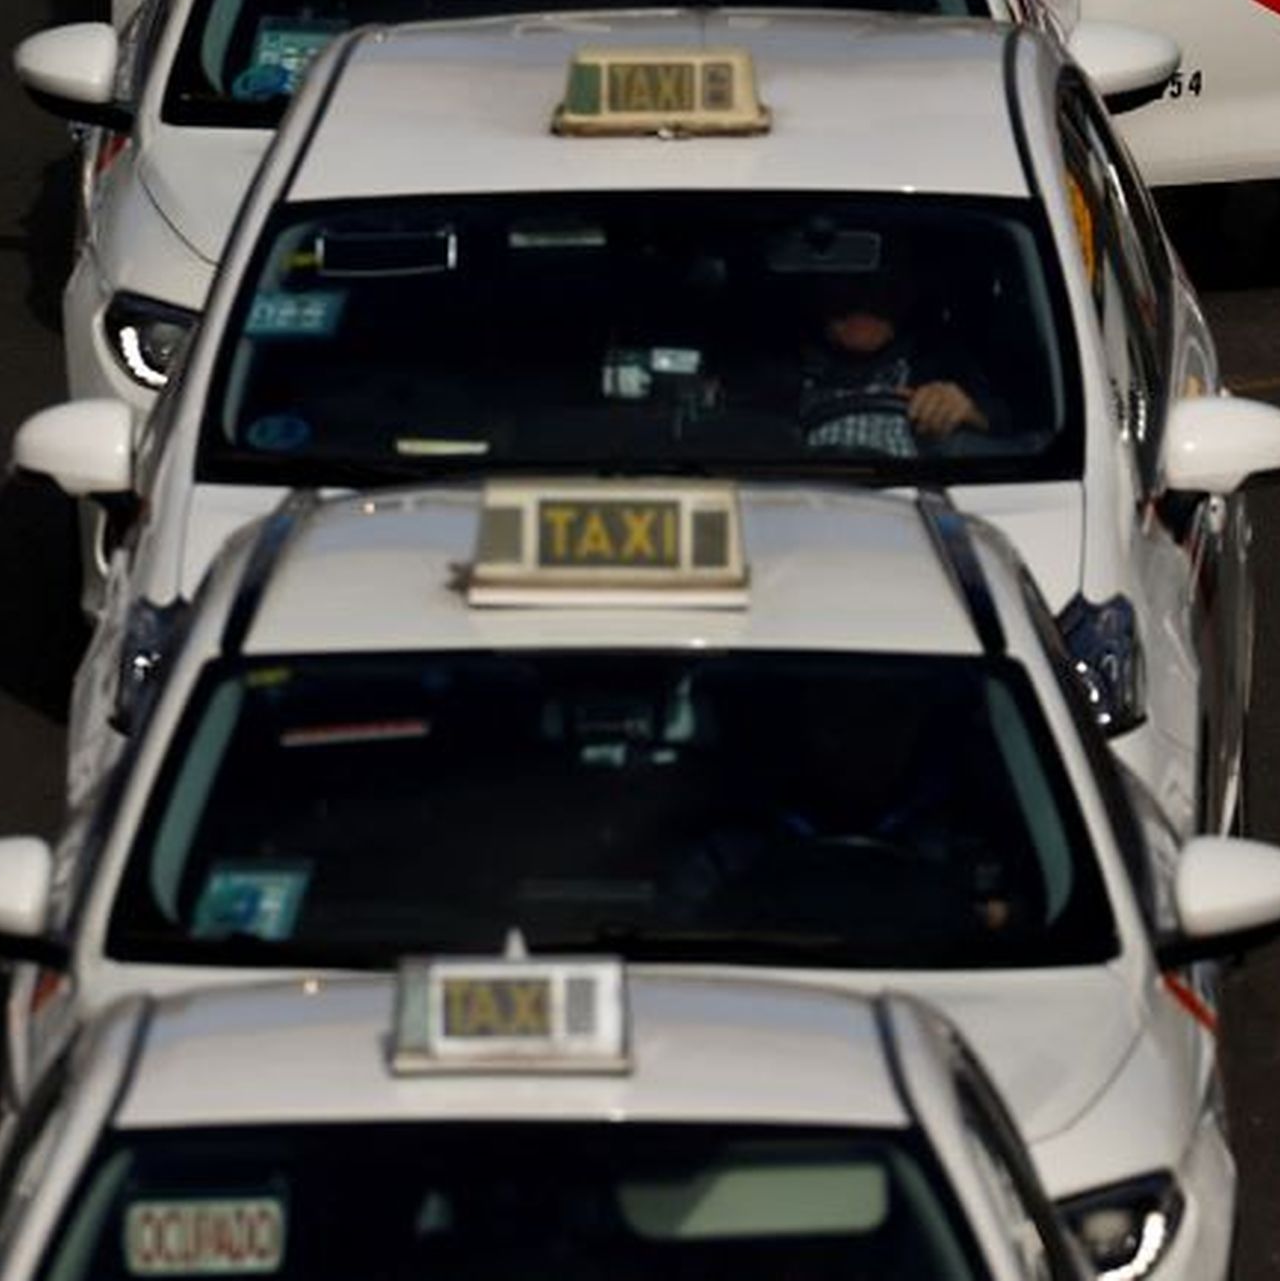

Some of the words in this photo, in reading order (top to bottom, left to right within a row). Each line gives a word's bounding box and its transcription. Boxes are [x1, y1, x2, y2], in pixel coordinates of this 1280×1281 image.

[610, 68, 690, 109] TAXI
[546, 512, 675, 559] TAXI
[450, 982, 549, 1032] TAXI
[137, 1207, 282, 1265] OCUPADO
